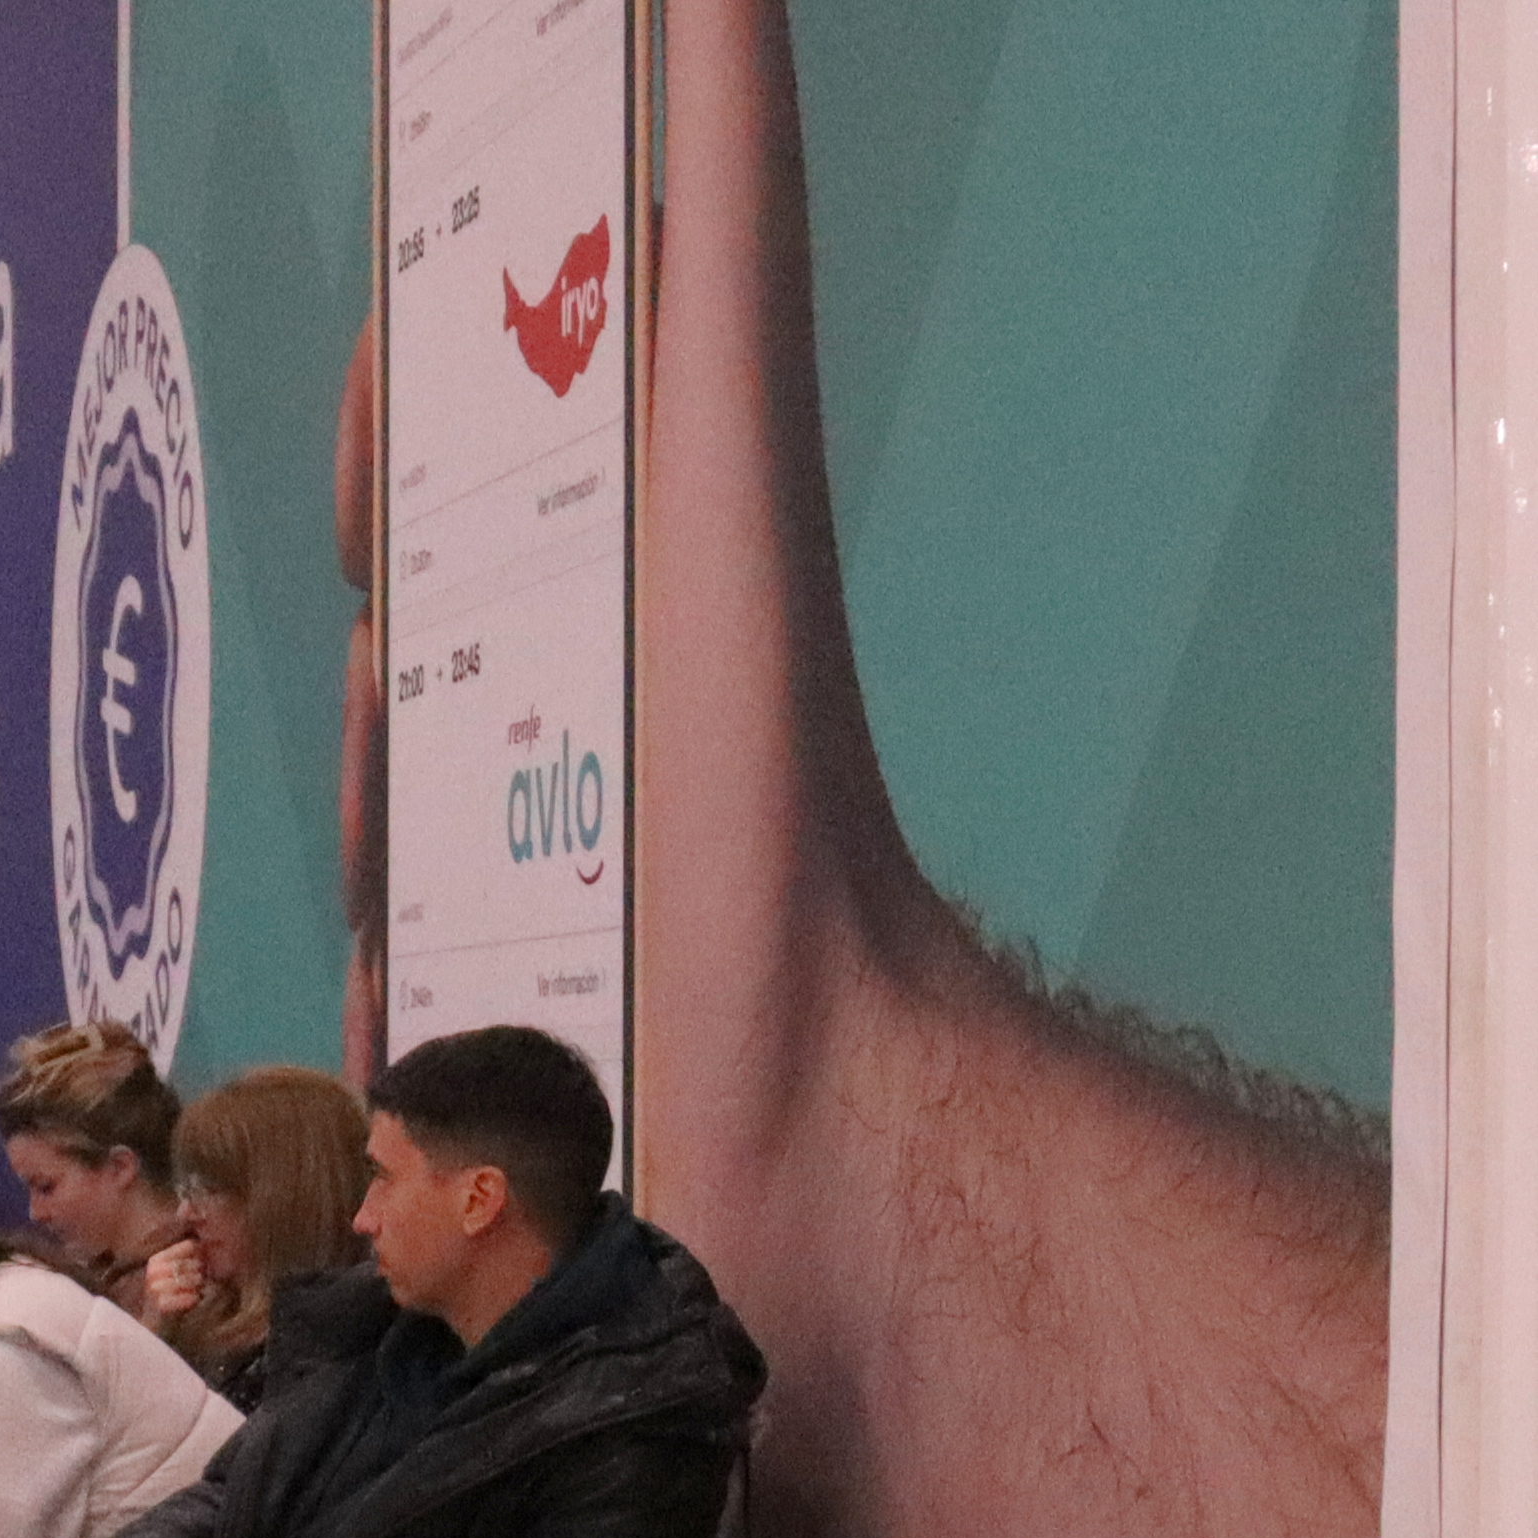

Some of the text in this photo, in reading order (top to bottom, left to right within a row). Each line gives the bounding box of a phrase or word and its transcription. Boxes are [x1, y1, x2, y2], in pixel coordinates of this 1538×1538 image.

[560, 275, 600, 347] iryo
[72, 297, 195, 551] MEJOR PRECIO
[507, 703, 542, 752] renfe
[507, 728, 604, 864] avlo
